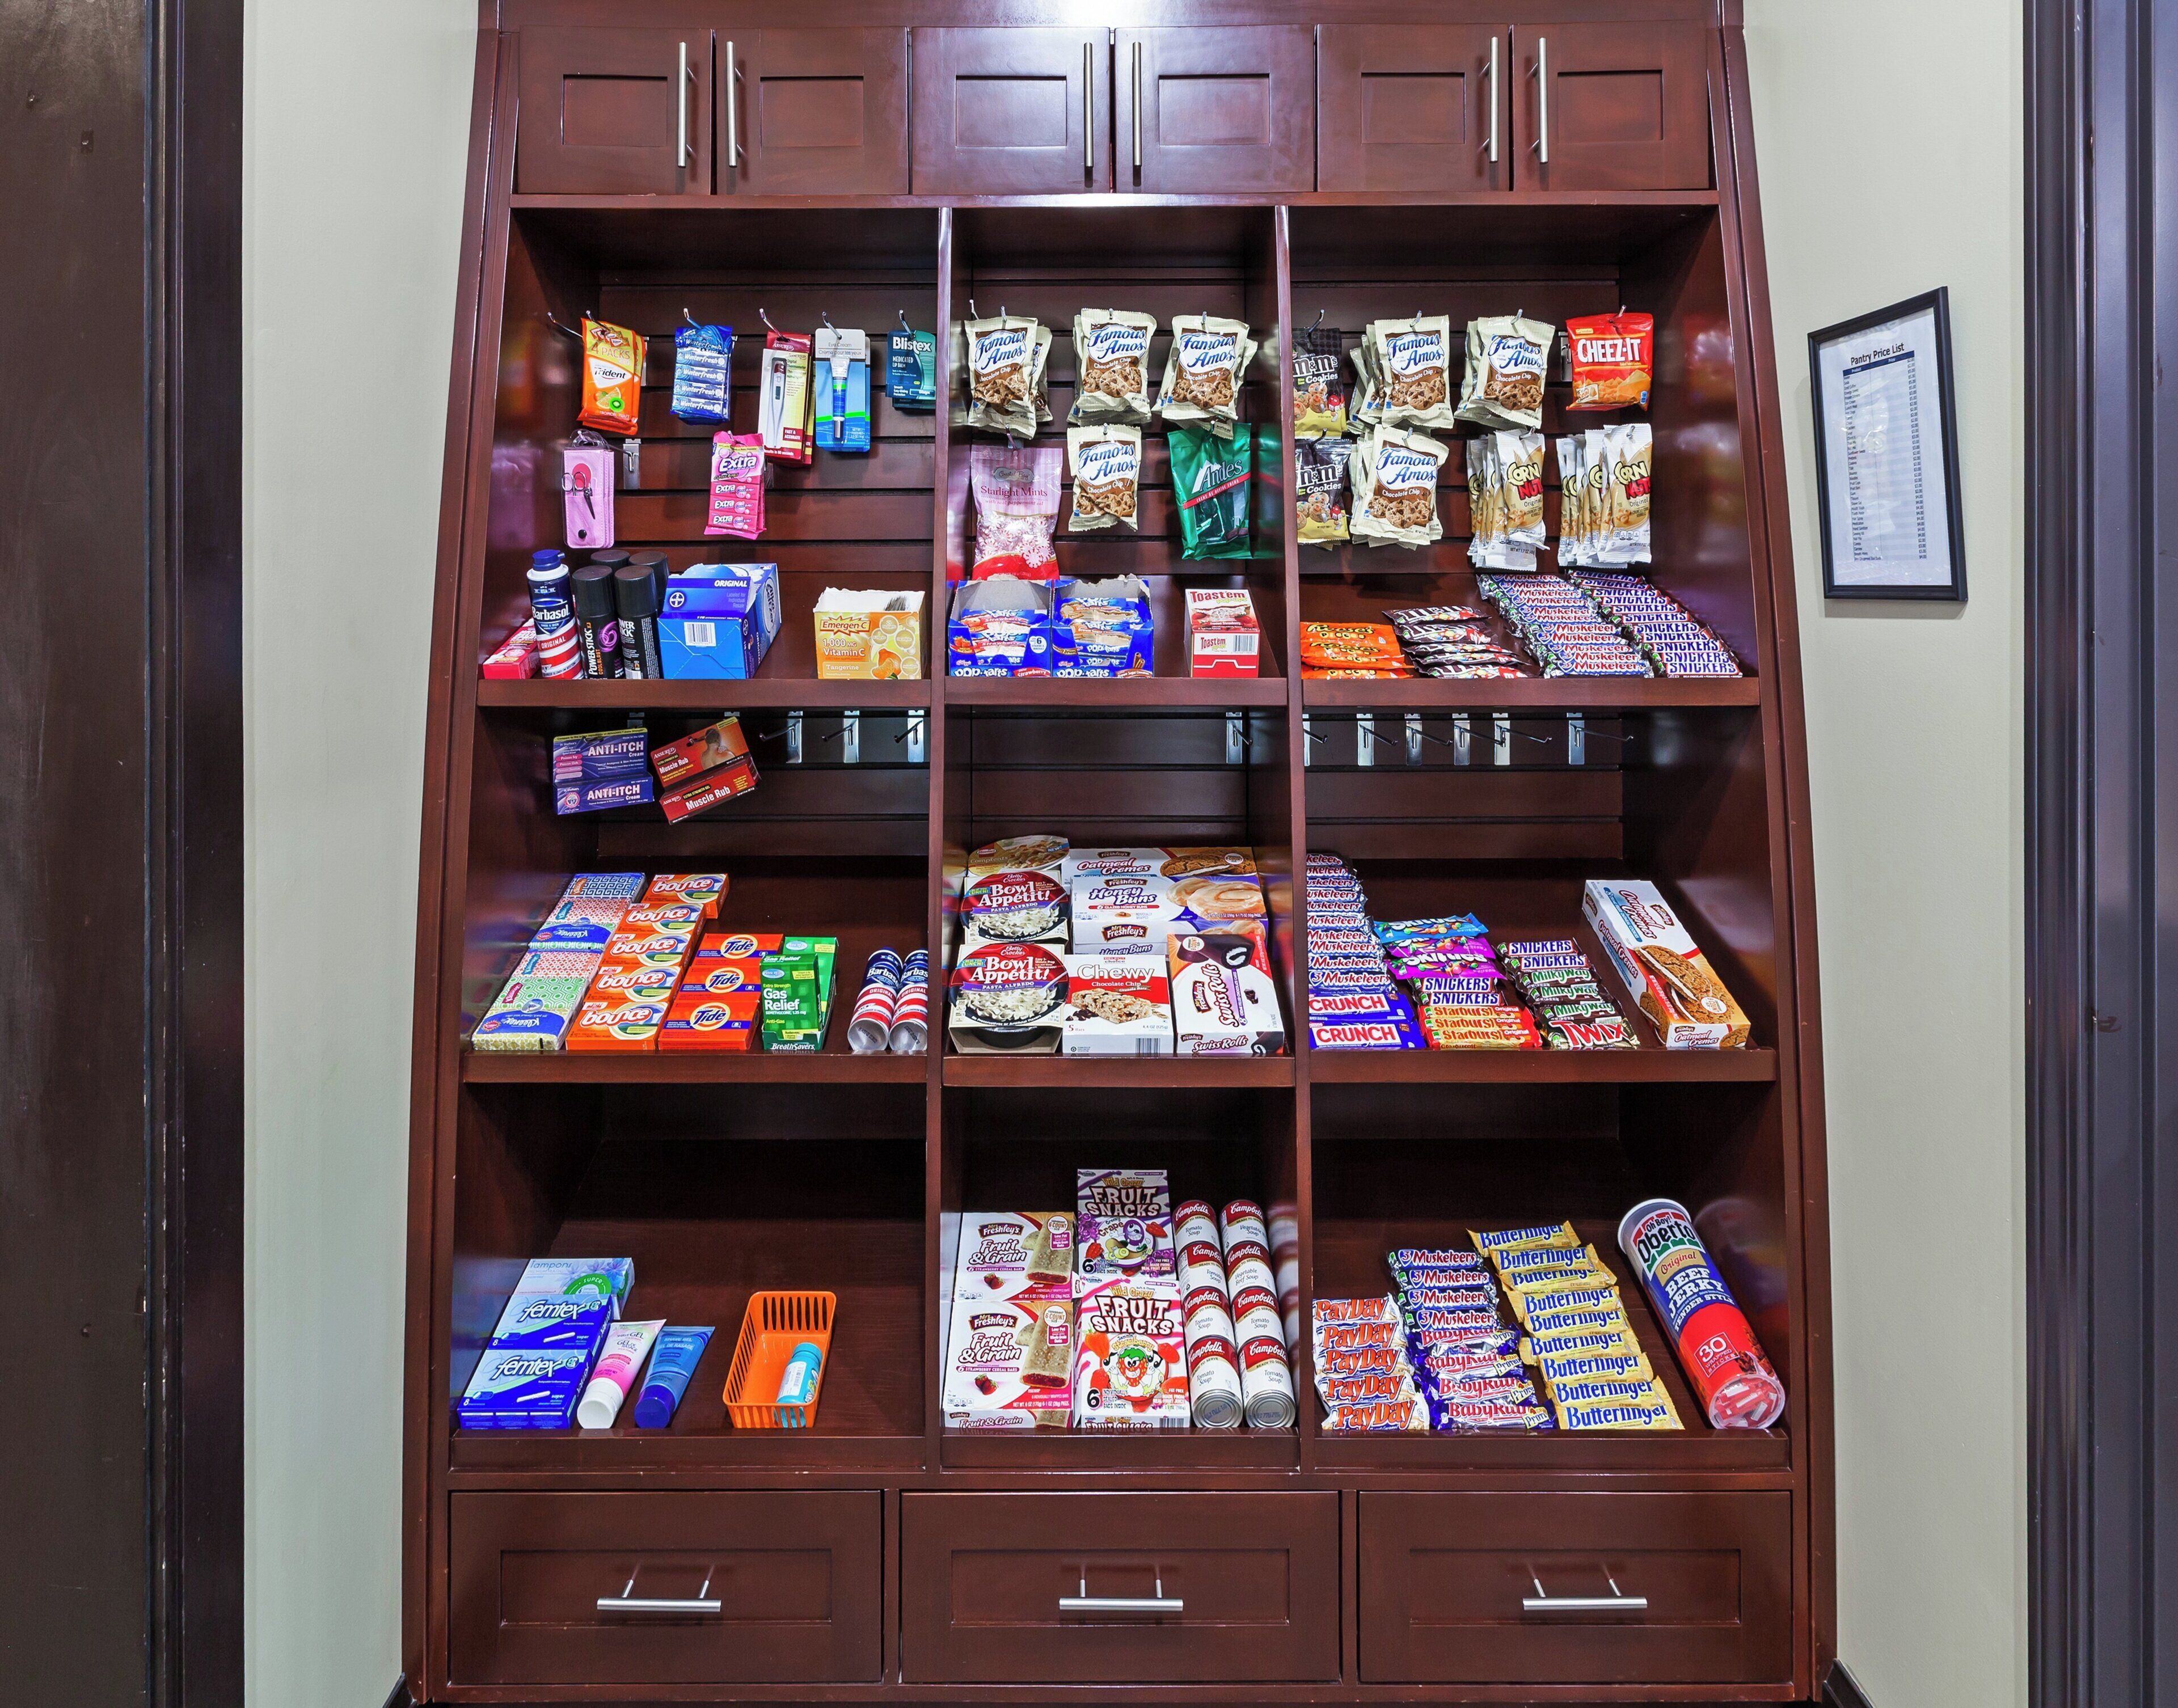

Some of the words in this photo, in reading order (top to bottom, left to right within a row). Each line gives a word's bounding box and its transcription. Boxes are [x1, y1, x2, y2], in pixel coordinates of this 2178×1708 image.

[893, 336, 931, 352] Blistex
[1088, 327, 1146, 346] Famous
[591, 340, 599, 354] 4
[602, 347, 630, 359] PACKS
[1097, 339, 1147, 359] Amos
[1578, 339, 1641, 363] CHEEZ-IT
[1851, 353, 1872, 365] Pantry
[1873, 348, 1890, 359] Price
[1892, 343, 1905, 354] List
[684, 353, 718, 363] Winterfresh
[1094, 359, 1119, 369] Chocolate
[594, 367, 626, 379] Trident
[683, 369, 716, 379] Winterfresh
[1306, 373, 1338, 383] Cookies
[1376, 447, 1436, 470] Famous
[1202, 459, 1242, 488] Andes
[1386, 467, 1436, 484] Amos
[1507, 462, 1540, 486] CORN
[1614, 461, 1648, 485] CORN
[716, 485, 735, 493] Extra
[981, 485, 1019, 498] Starlight
[1020, 488, 1048, 497] Mints
[1307, 483, 1341, 493] Cookies
[1382, 489, 1408, 498] Chocolate
[715, 500, 734, 509] Extra
[714, 515, 733, 524] Extra
[1191, 590, 1246, 603] Toast'em
[533, 604, 570, 621] Barbasol
[822, 620, 867, 630] Emergen-C
[822, 639, 845, 648] 1,000
[824, 648, 856, 657] Vitamin
[588, 741, 644, 757] ANTI-ITCH
[587, 784, 640, 800] ANTI-ITCH
[686, 792, 715, 810] Muscle
[714, 785, 731, 800] Rub
[1078, 858, 1136, 870] Oatmeal
[1101, 865, 1151, 875] Cremes
[652, 878, 713, 894] bounce
[991, 882, 1036, 895] Bowl
[1089, 887, 1142, 900] Honey
[1115, 894, 1157, 905] Buns
[626, 908, 690, 924] bounce
[1107, 928, 1145, 937] Freshley's
[610, 938, 677, 956] bounce
[1511, 941, 1572, 954] SNICKERS
[986, 956, 1034, 970] Bowl
[705, 973, 740, 990] Tide
[1077, 965, 1155, 983] Chewy
[901, 988, 926, 997] ORIGINAL
[1425, 978, 1490, 991] SNICKERS
[763, 988, 787, 1000] Gas
[869, 988, 893, 998] ORIGINAL
[764, 999, 800, 1010] Relief
[1309, 995, 1385, 1012] CRUNCH
[690, 1008, 727, 1026] Tide
[1435, 1018, 1495, 1028] Starburst
[1316, 1026, 1395, 1042] CRUNCH
[1442, 1029, 1503, 1041] Starburst
[1551, 1021, 1629, 1046] TWIX
[1674, 1031, 1711, 1042] Oatmeal
[1688, 1037, 1719, 1046] Cremes
[1192, 1041, 1222, 1052] Swiss
[1222, 1034, 1248, 1047] Rolls
[1121, 1178, 1144, 1187] Crazy
[1090, 1186, 1158, 1203] FRUIT
[1086, 1203, 1161, 1216] SNACKS
[1175, 1203, 1210, 1220] Campbell's
[1098, 1221, 1124, 1237] Grape
[1646, 1221, 1654, 1233] Oh
[1655, 1215, 1672, 1227] Boy!
[1481, 1225, 1563, 1248] Butterfinger
[1637, 1220, 1695, 1264] Oberto
[980, 1239, 1018, 1254] Fruit
[1227, 1246, 1262, 1264] Campbell's
[1402, 1250, 1409, 1259] 3
[1413, 1250, 1475, 1264] Musketeers
[1500, 1248, 1587, 1270] Butterfinger
[530, 1260, 572, 1269] Tampons
[1235, 1268, 1257, 1279] Vegetable
[1235, 1275, 1246, 1285] Beef
[1412, 1270, 1421, 1281] 3
[1425, 1270, 1487, 1284] Musketeers
[1665, 1267, 1711, 1299] BEEF
[1669, 1279, 1724, 1319] JERKY
[517, 1300, 586, 1322] femtex
[1096, 1296, 1171, 1319] FRUIT
[1315, 1299, 1387, 1321] PayDay
[974, 1316, 1015, 1328] Freshley's
[1092, 1317, 1174, 1334] SNACKS
[1194, 1317, 1213, 1326] Tomato
[970, 1331, 1014, 1348] Fruit
[1323, 1322, 1397, 1348] PayDay
[1699, 1336, 1727, 1363] 30
[489, 1355, 563, 1381] femtex
[1326, 1349, 1400, 1375] PayDay
[1264, 1370, 1284, 1379] Tomato
[1087, 1389, 1100, 1408] 6
[993, 1416, 1023, 1426] Grain
